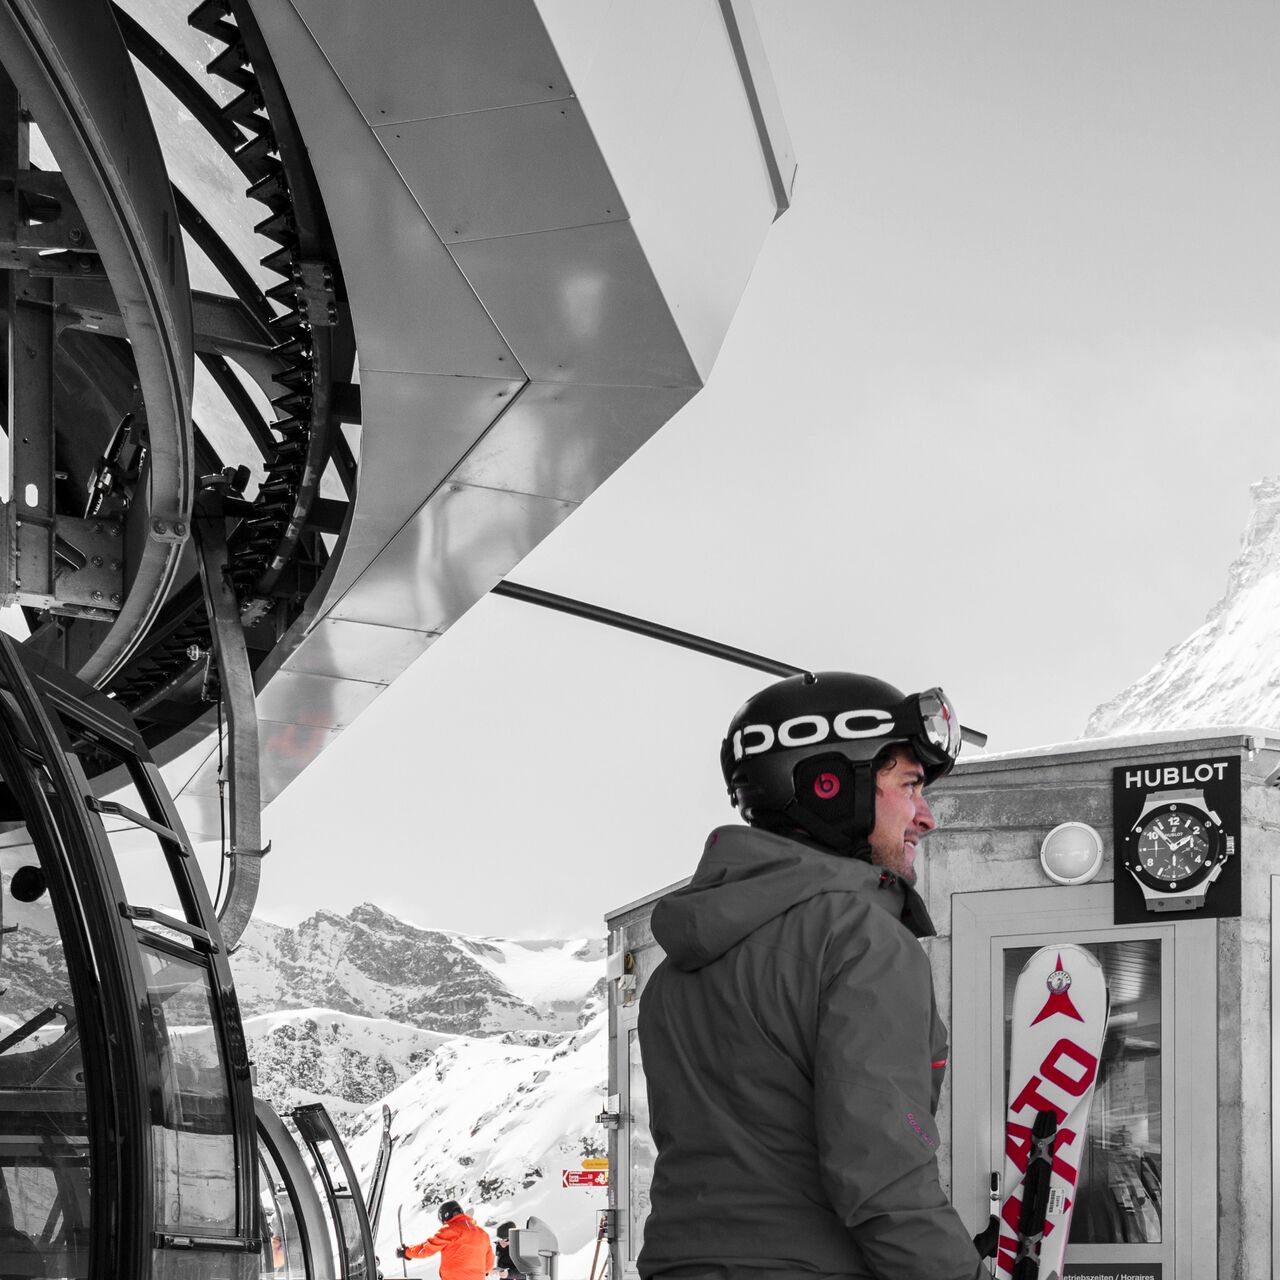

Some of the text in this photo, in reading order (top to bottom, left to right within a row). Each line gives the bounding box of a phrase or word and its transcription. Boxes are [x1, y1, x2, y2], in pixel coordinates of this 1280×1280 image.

[1125, 763, 1228, 789] HUBLOT
[1168, 817, 1180, 826] 12
[1193, 826, 1200, 835] 2
[1147, 832, 1158, 840] 10
[1147, 858, 1154, 867] 8
[1194, 855, 1201, 864] 4
[1062, 1273, 1114, 1280] etriebszeiten
[1121, 1273, 1154, 1280] Horaires
